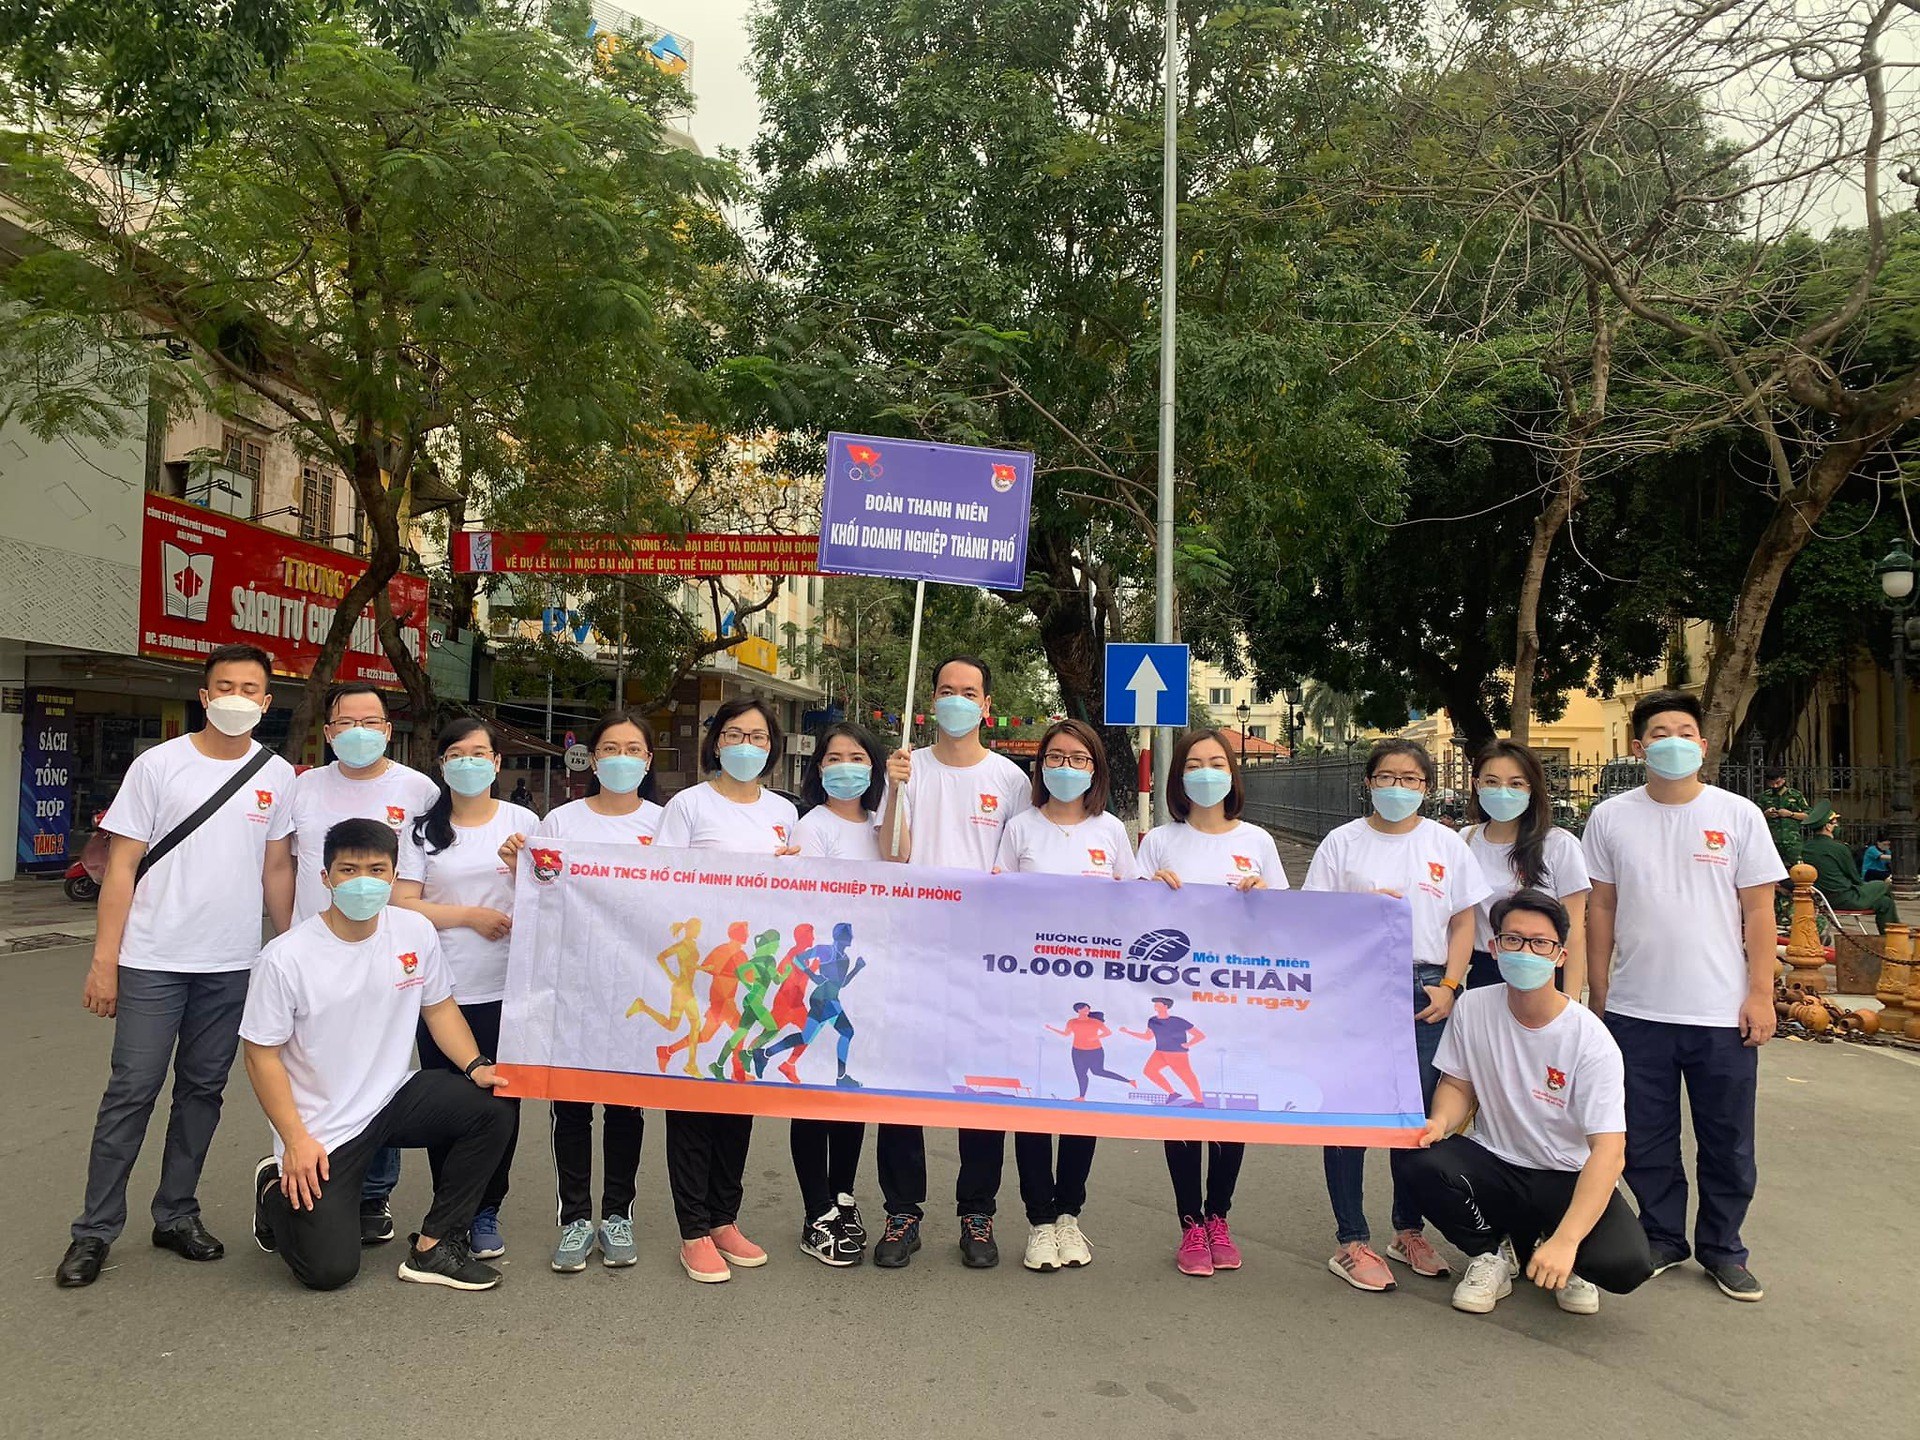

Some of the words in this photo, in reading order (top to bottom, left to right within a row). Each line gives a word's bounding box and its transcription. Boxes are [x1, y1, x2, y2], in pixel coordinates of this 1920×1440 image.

[865, 492, 904, 513] ĐOÀN
[907, 498, 951, 519] THANH
[955, 502, 989, 523] NIÊN
[704, 536, 726, 552] BIỂU
[728, 539, 741, 553] VÀ
[743, 539, 770, 553] ĐOÀN
[772, 539, 792, 555] VẬN
[831, 517, 859, 546] KHỐI
[861, 525, 902, 550] DOANH
[904, 527, 948, 559] NGHIỆP
[951, 532, 989, 560] THÀNH
[991, 533, 1017, 562] PHỐ
[282, 555, 346, 600] TRUNG
[575, 557, 596, 572] MẠC
[637, 554, 654, 570] THỂ
[657, 558, 676, 573] DỤC
[679, 554, 697, 570] THỂ
[699, 559, 723, 571] THAO
[726, 557, 758, 571] THÀNH
[760, 556, 780, 571] PHỐ
[782, 557, 798, 571] HẢI
[231, 580, 281, 638] SÁCH
[282, 596, 307, 649] TỰ
[307, 603, 337, 646] CH
[39, 727, 68, 751] SÁCH
[35, 758, 68, 786] TỔNG
[36, 797, 65, 822] HỢP
[34, 828, 57, 856] TẦNG
[56, 833, 64, 855] 2
[570, 862, 610, 877] ĐOÀN
[613, 866, 647, 879] TNCS
[650, 866, 670, 882] HỒ
[673, 868, 695, 884] CHÍ
[698, 872, 732, 886] MINH
[735, 872, 767, 888] KHỐI
[770, 877, 817, 892] DOANH
[820, 879, 867, 897] NGHIỆP
[870, 884, 889, 896] TP.
[892, 882, 913, 898] HẢI
[917, 885, 962, 902] PHÒNG
[982, 953, 1094, 979] 10.000
[1210, 968, 1312, 993] CHÂN
[1225, 954, 1270, 967] thanh
[1275, 957, 1310, 969] niên
